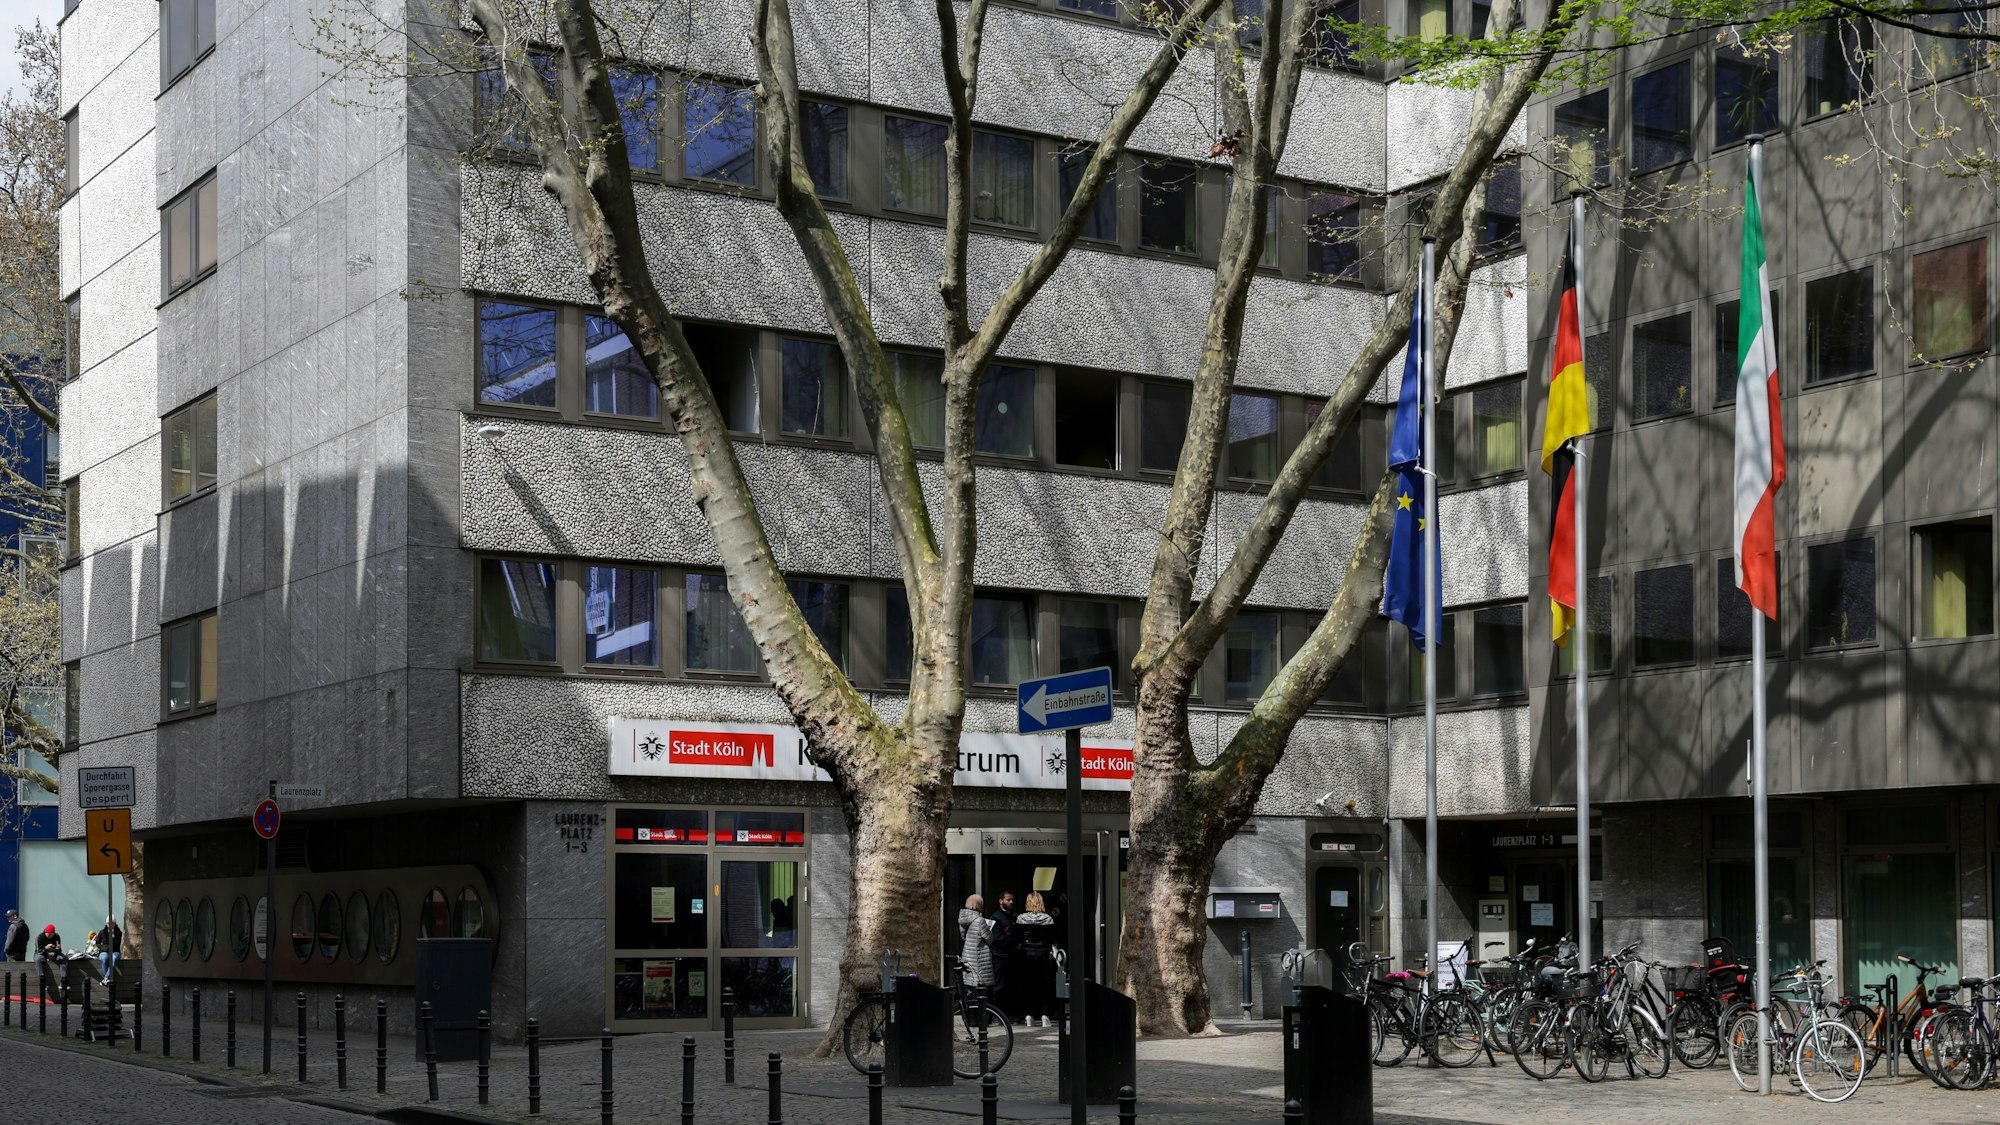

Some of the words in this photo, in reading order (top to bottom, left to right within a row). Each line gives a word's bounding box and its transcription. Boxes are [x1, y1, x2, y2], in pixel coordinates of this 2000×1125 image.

[1044, 690, 1106, 711] Einbahnstraße
[672, 740, 710, 756] Stadt
[713, 741, 745, 757] Köln
[1080, 756, 1106, 770] tadt
[1108, 757, 1135, 771] Köln
[86, 772, 127, 781] Durchfahrt
[84, 783, 130, 794] Sporergasse
[280, 786, 322, 798] Laurenzplatz
[85, 794, 130, 806] gesperrt
[103, 819, 114, 833] U
[560, 827, 593, 840] PLATZ
[1000, 837, 1066, 847] Kundenzentrum
[1492, 835, 1537, 847] LAURENZPLATZ
[1541, 834, 1554, 845] 1-3
